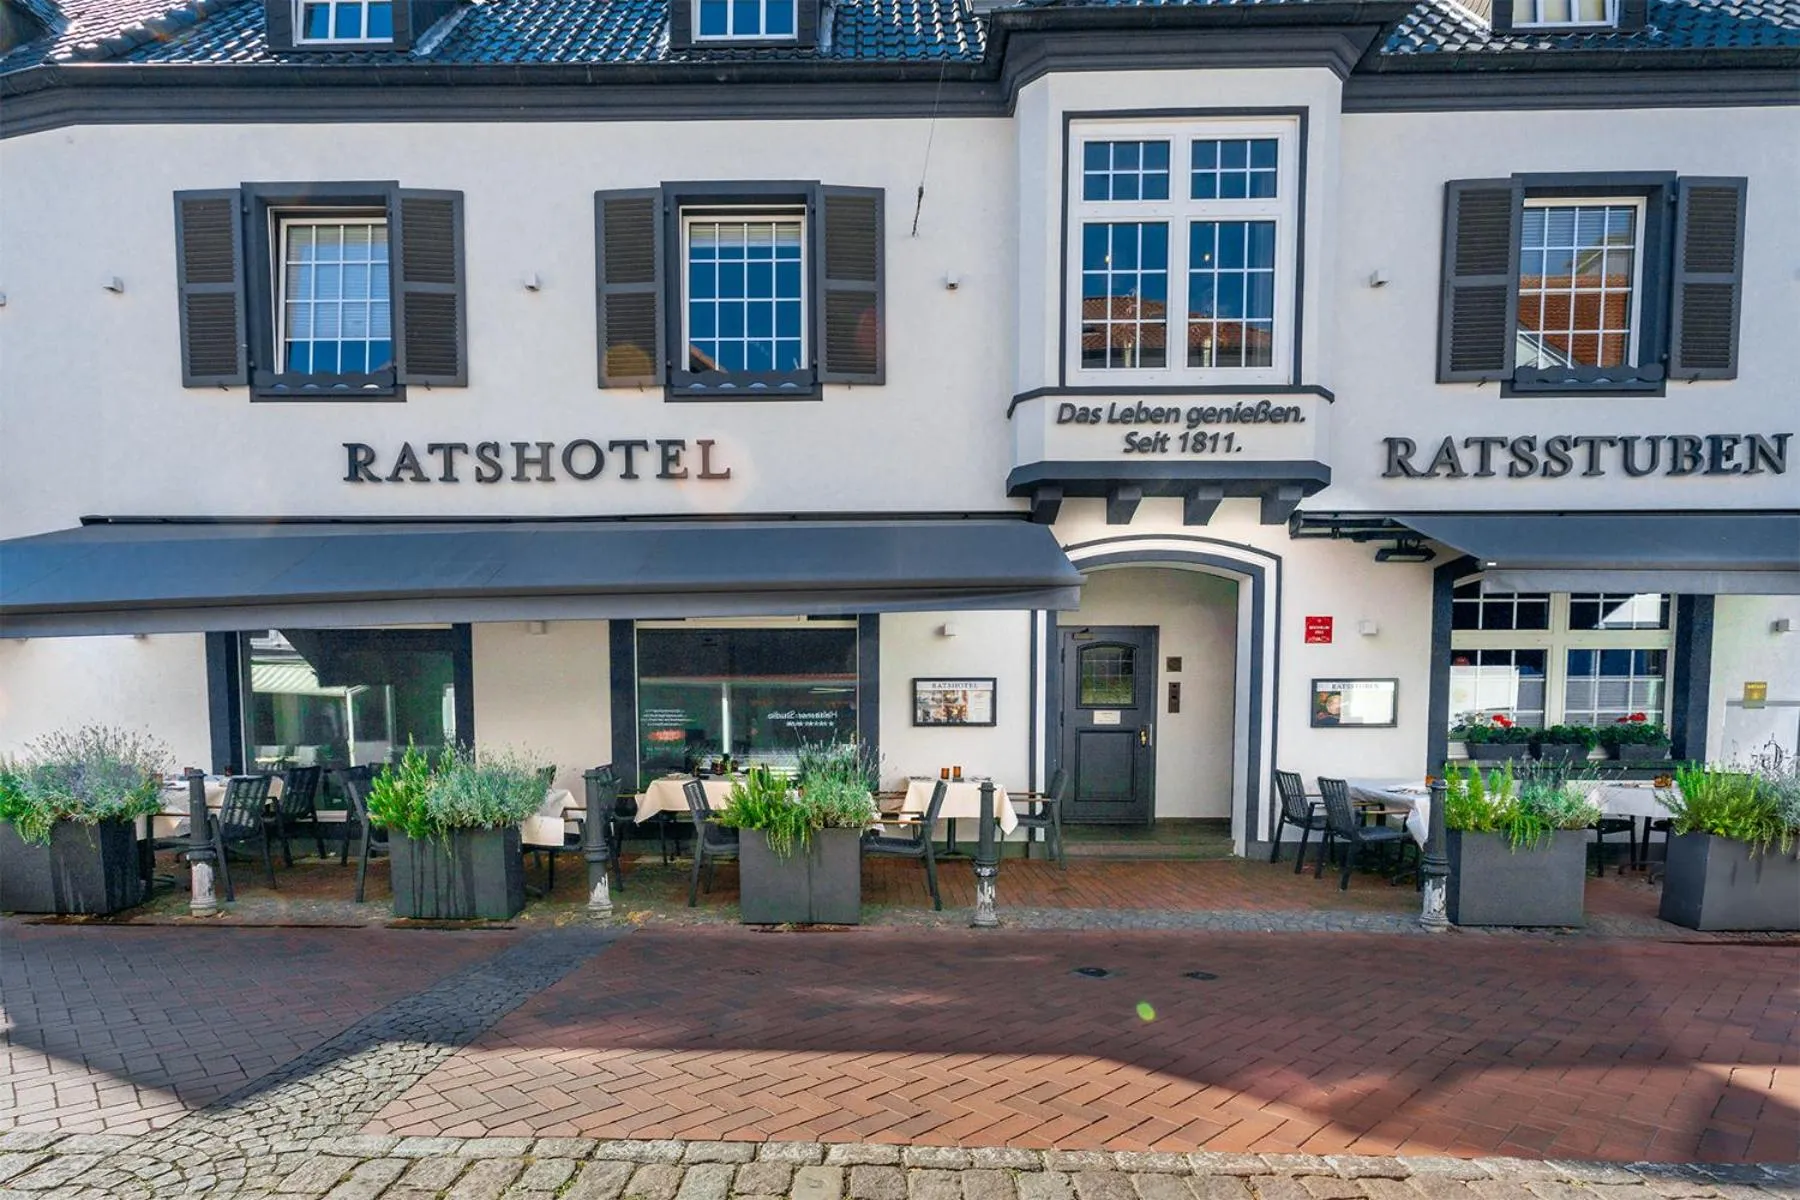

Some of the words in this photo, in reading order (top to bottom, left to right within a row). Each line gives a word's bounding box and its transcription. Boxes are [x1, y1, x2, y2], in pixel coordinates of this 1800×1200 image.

[1056, 401, 1102, 425] Das
[1107, 400, 1181, 425] Leben
[1185, 399, 1306, 429] genießen.
[341, 438, 732, 484] RATSHOTEL
[1122, 431, 1171, 454] Seit
[1178, 431, 1242, 454] 1811.
[1381, 432, 1794, 479] RATSSTUBEN
